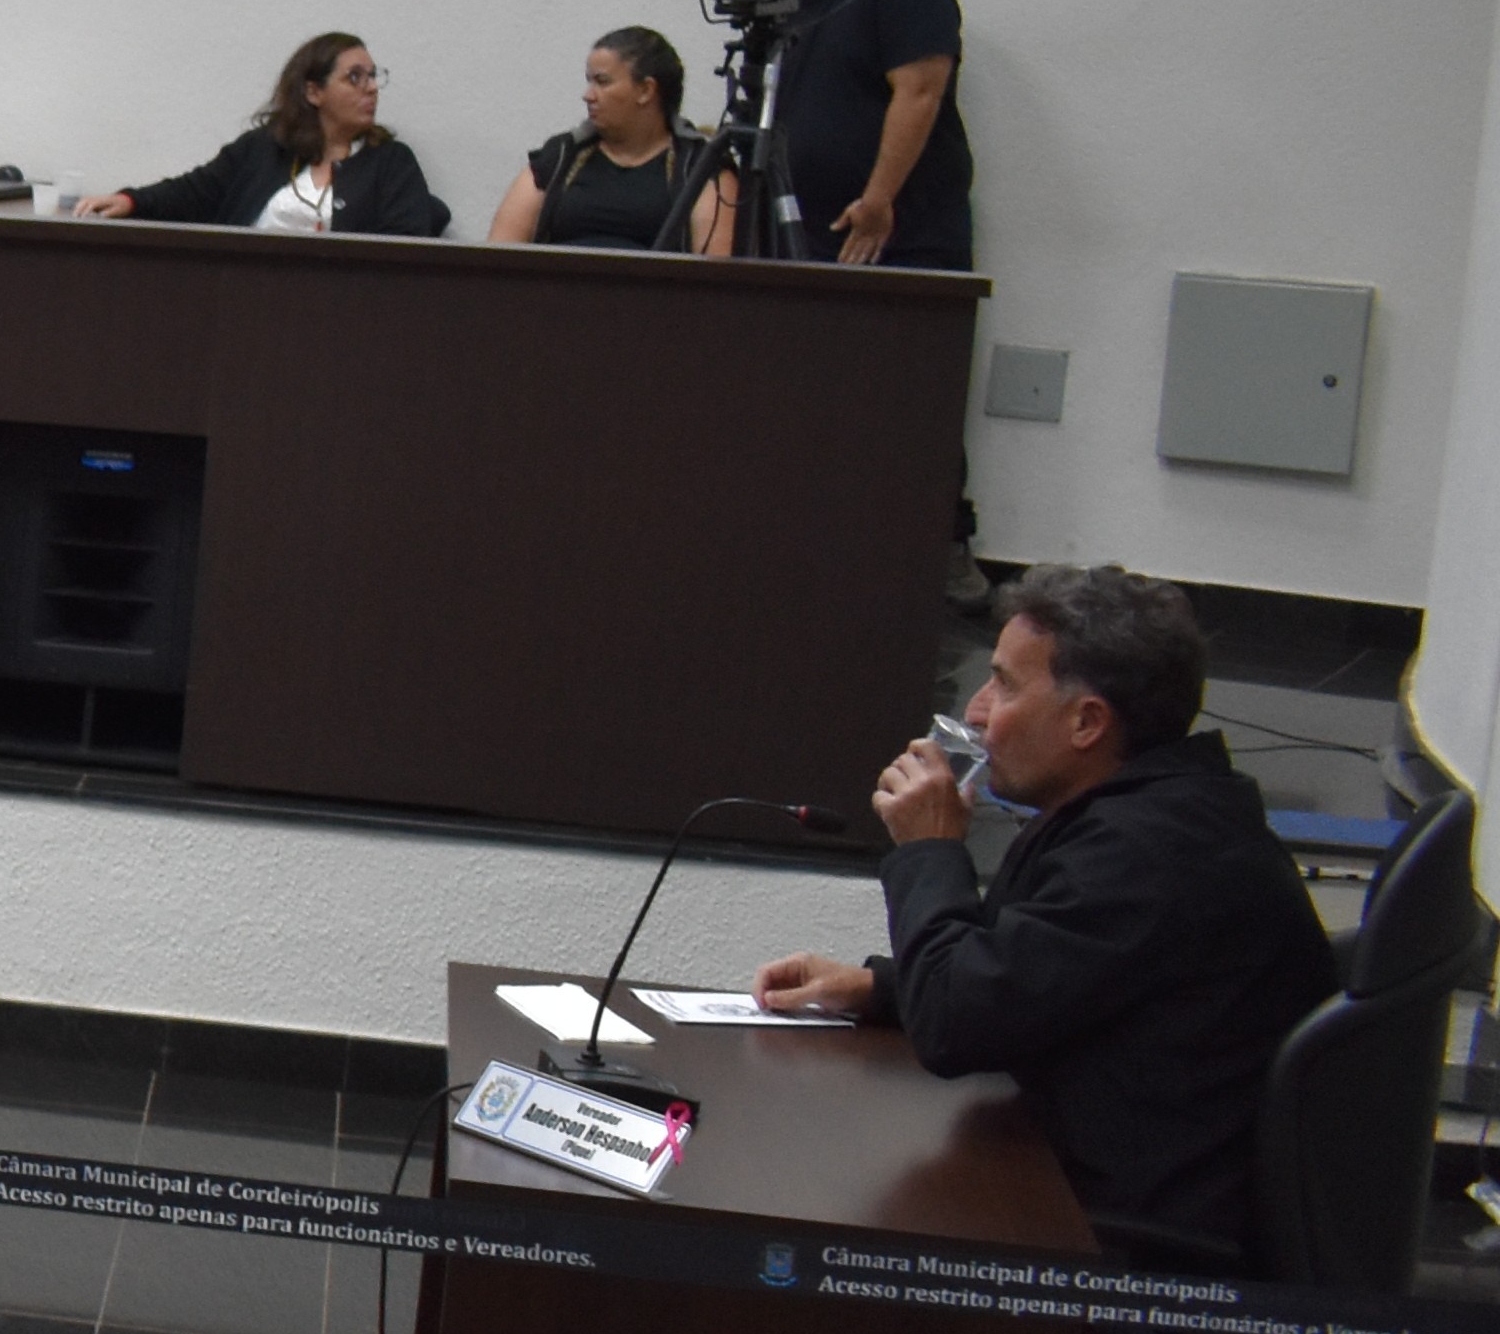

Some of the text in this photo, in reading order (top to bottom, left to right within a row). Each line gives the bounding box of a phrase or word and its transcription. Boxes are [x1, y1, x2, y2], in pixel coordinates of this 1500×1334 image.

[522, 1103, 585, 1140] Anderson
[83, 1164, 190, 1195] Municipal
[197, 1178, 223, 1197] de
[228, 1182, 380, 1216] Cordeirópolis
[72, 1193, 154, 1217] restrito
[159, 1206, 237, 1227] apenas
[242, 1214, 292, 1234] para
[299, 1219, 439, 1250] funcionários
[445, 1239, 457, 1251] e
[464, 1236, 595, 1267] Vereadores.
[819, 1275, 897, 1299] Acesso
[904, 1285, 992, 1309] restrito
[998, 1295, 1081, 1316] apenas
[1088, 1303, 1140, 1324] para
[822, 1246, 1239, 1303] Câmara Municipal de Cordeirópolis
